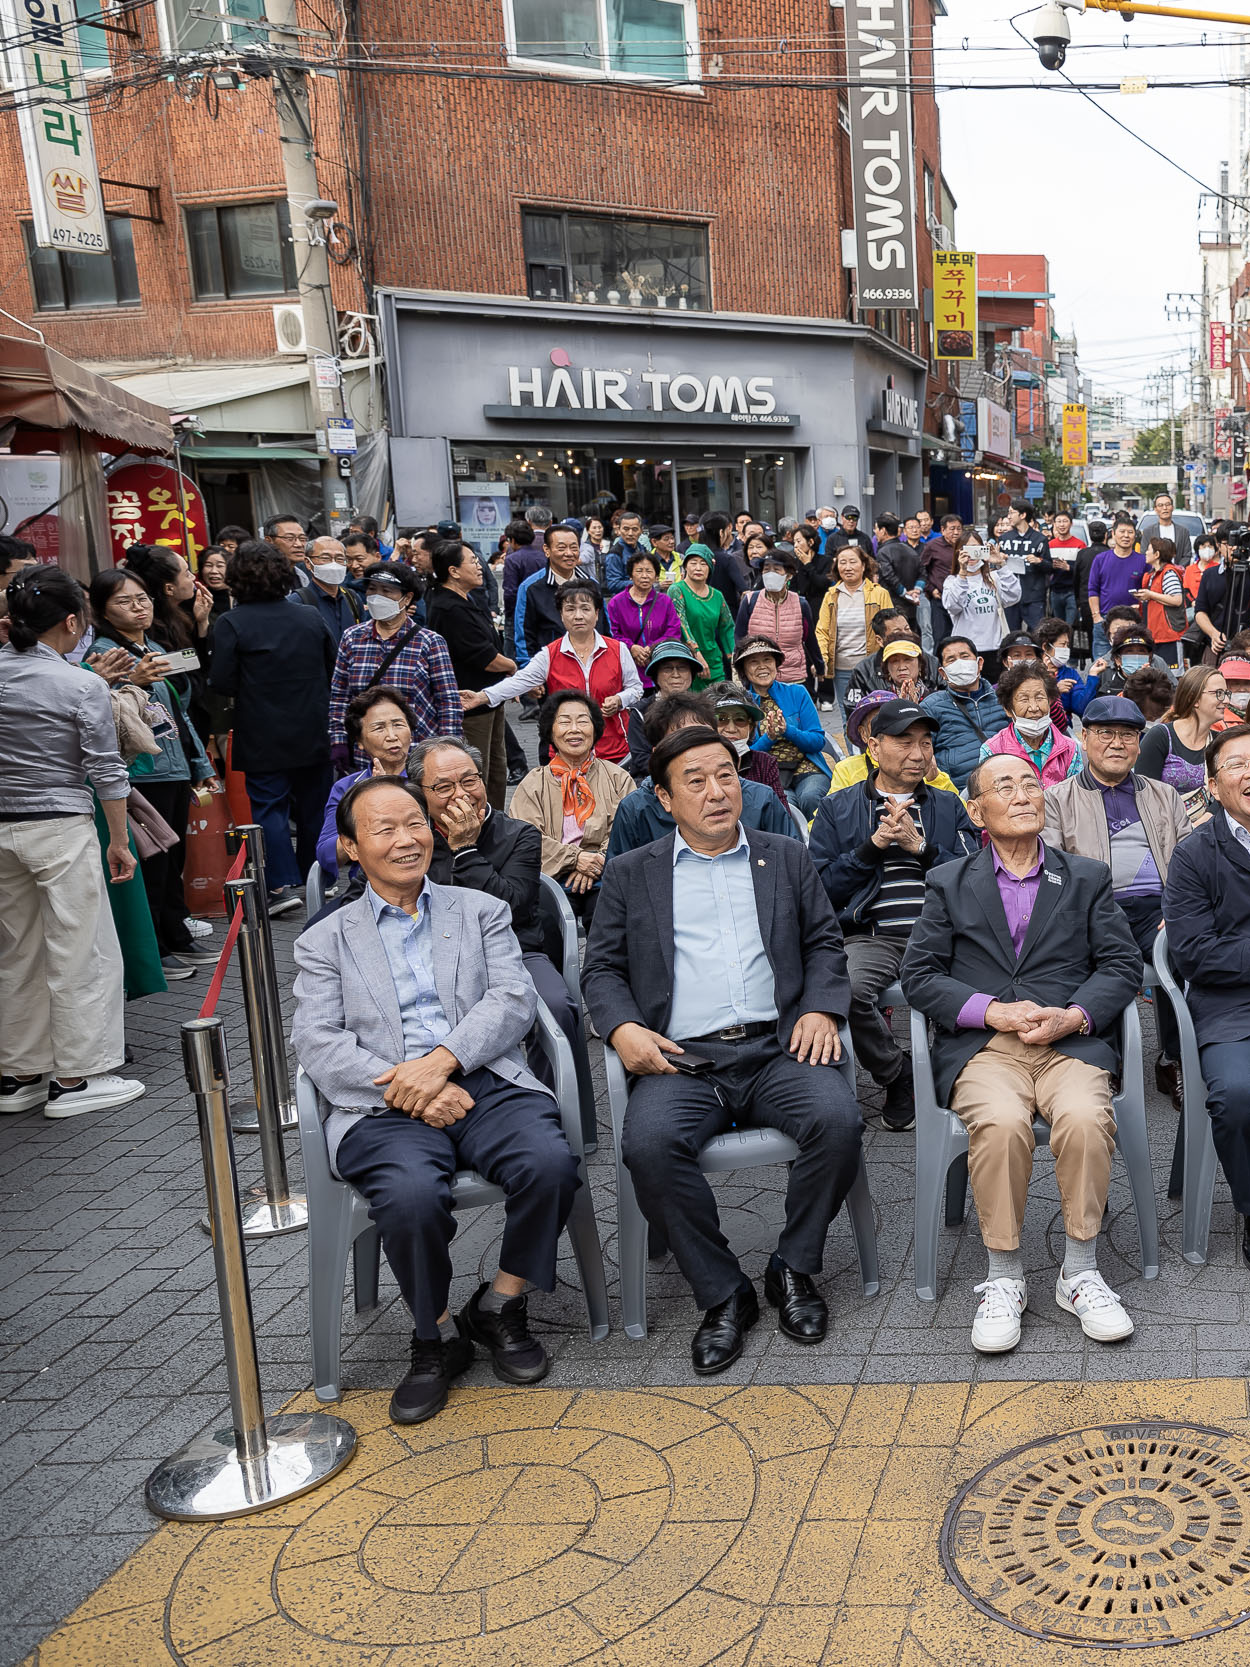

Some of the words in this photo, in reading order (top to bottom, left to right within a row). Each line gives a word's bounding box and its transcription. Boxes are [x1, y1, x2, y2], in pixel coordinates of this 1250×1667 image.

[857, 0, 899, 119] HAIR
[52, 172, 88, 214] 쌀
[862, 130, 906, 271] TOMS
[52, 226, 104, 248] 497-4225
[936, 253, 974, 267] 부뚜막
[863, 288, 912, 300] 466.9336
[941, 269, 967, 329] 쭈꾸미
[508, 366, 633, 410] HAIR
[641, 372, 776, 414] TOMS
[975, 606, 995, 614] TRACK
[848, 689, 862, 702] 45
